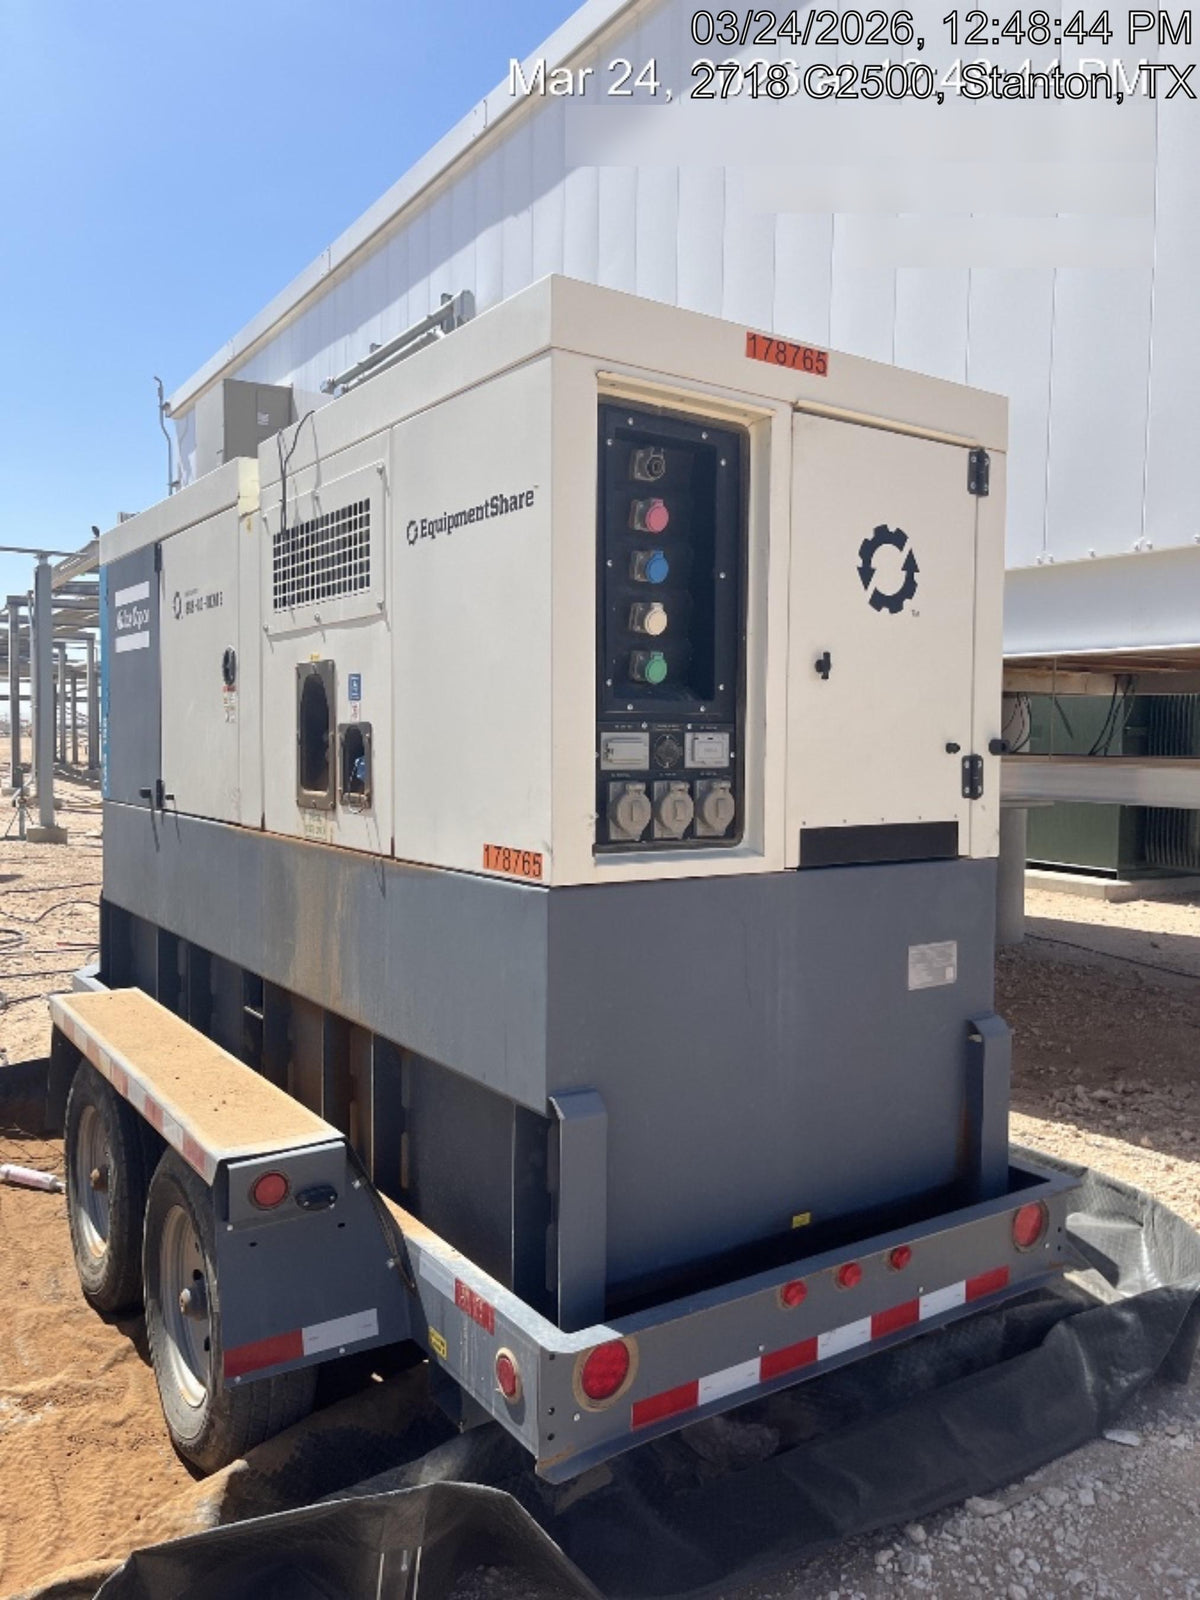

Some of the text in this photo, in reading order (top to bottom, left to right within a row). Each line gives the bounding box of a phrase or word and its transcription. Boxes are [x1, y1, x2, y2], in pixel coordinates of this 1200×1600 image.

[747, 333, 828, 375] 178765
[420, 489, 535, 540] EquipmentShare
[484, 844, 542, 878] 178765
